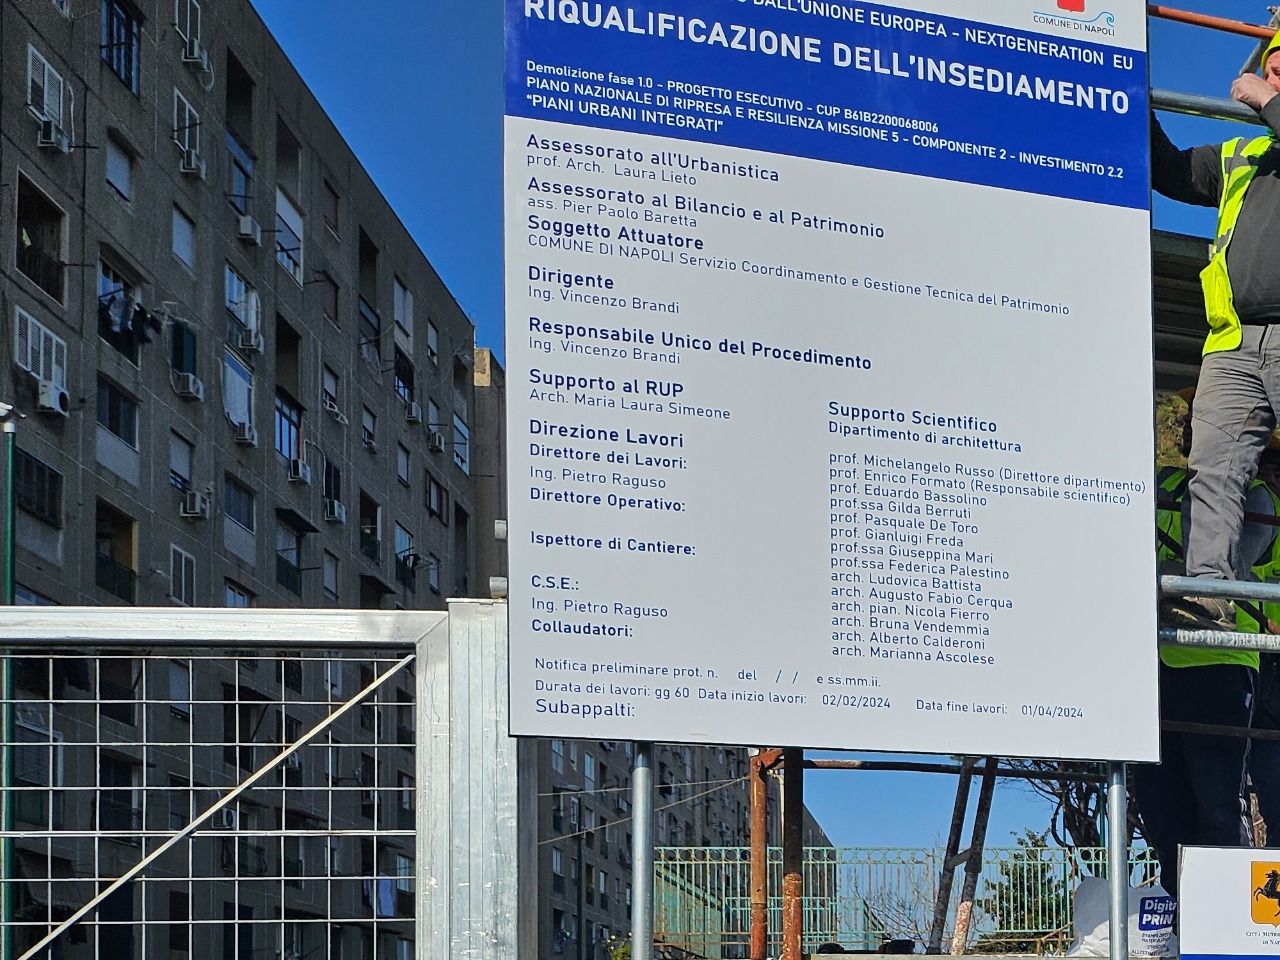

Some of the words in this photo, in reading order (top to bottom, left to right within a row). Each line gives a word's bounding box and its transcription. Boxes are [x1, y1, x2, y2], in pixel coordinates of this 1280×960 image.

[870, 12, 948, 38] EUROPEA
[965, 28, 1105, 66] NEXTGENERATION
[1113, 53, 1134, 71] EU
[1033, 15, 1072, 29] COMUNE
[1074, 22, 1083, 30] DI
[1085, 24, 1116, 36] NAPOLI
[524, 0, 822, 63] RIQUALIFICAZIONE
[833, 42, 1129, 114] DELL'INSEDIAMENTO
[526, 59, 605, 82] Demolizione
[608, 72, 635, 86] fase
[637, 76, 653, 89] 1.0
[667, 80, 732, 100] PROGETTO
[736, 90, 803, 112] ESECUTIVO
[816, 104, 841, 117] CUP
[844, 108, 939, 133] B61B2200068006
[526, 94, 574, 112] "PIANI
[578, 100, 636, 121] URBANI
[641, 109, 724, 132] INTEGRATI"
[526, 75, 570, 93] PIANO
[574, 82, 652, 105] NAZIONALE
[656, 94, 669, 107] DI
[673, 96, 732, 117] RIPRESA
[735, 106, 744, 119] E
[747, 108, 825, 131] RESILIENZA
[827, 121, 889, 142] MISSIONE
[891, 131, 899, 143] 5
[912, 134, 997, 158] COMPONENTE
[999, 148, 1007, 160] 2
[1019, 151, 1105, 176] INVESTIMENTO
[1107, 166, 1124, 179] 2.2
[526, 133, 644, 163] Assessorato
[650, 151, 779, 182] all'Urbanistica
[527, 214, 611, 239] Soggetto
[617, 226, 704, 250] Attuatore
[528, 265, 614, 290] Dirigente
[529, 316, 655, 345] Responsabile
[661, 331, 712, 351] Unico
[718, 338, 746, 356] del
[752, 341, 872, 370] Procedimento
[529, 368, 616, 392] Supporto
[622, 379, 640, 394] al
[646, 380, 684, 398] RUP
[828, 401, 905, 423] Supporto
[911, 410, 997, 433] Scientifico
[529, 419, 619, 442] Direzione
[626, 428, 683, 448] Lavori
[829, 420, 920, 442] Dipartimento
[924, 431, 937, 444] di
[941, 435, 1022, 453] architettura
[829, 452, 860, 466] prof.
[864, 454, 951, 475] Michelangelo
[955, 463, 995, 478] Russo
[999, 467, 1060, 485] (Direttore
[1063, 474, 1146, 494] dipartimento)
[530, 487, 602, 505] Direttore
[607, 493, 686, 512] Operativo:
[830, 497, 884, 512] prof.ssa
[888, 500, 921, 515] Gilda
[925, 503, 971, 519] Berruti
[531, 530, 602, 549] Ispettore
[608, 537, 621, 550] di
[627, 538, 696, 556] Cantiere:
[531, 574, 579, 591] C.S.E.:
[531, 618, 633, 638] Collaudatori:
[535, 698, 635, 720] Subappalti:
